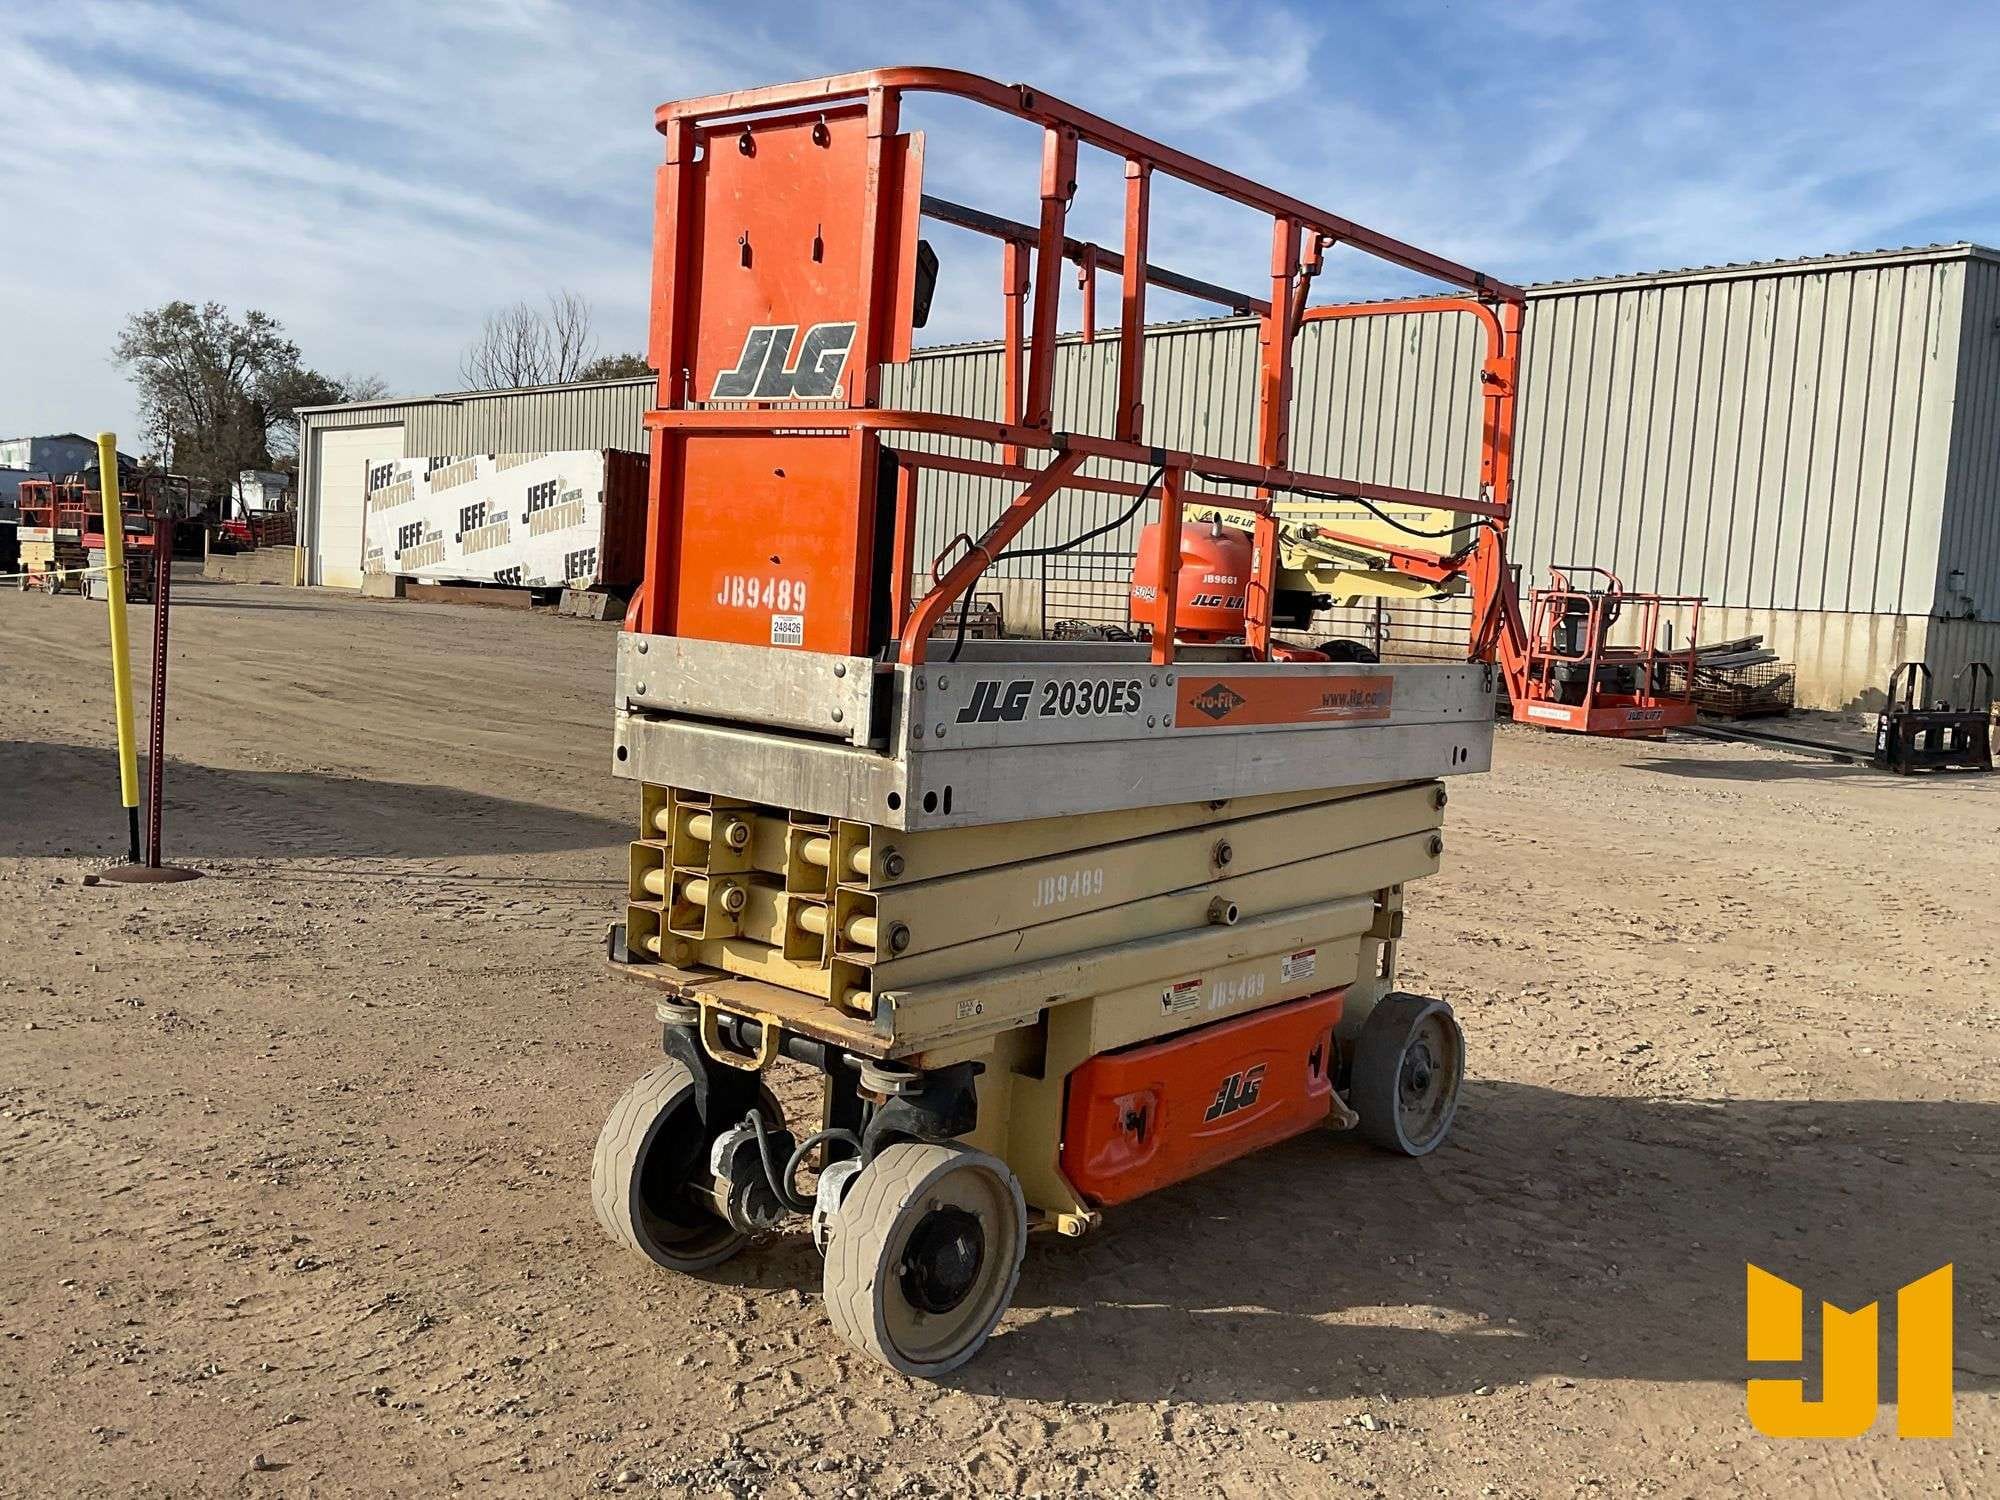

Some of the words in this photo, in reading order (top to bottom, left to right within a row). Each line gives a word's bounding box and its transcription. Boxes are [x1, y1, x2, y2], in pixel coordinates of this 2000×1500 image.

[711, 323, 857, 399] JLG
[366, 462, 394, 501] JEFF
[431, 459, 475, 494] MARTIN
[371, 480, 412, 513] MARTIN
[522, 479, 557, 524] JEFF
[455, 502, 485, 543] JEFF
[529, 499, 583, 537] MARTIN
[1241, 518, 1256, 528] LIF
[395, 521, 422, 560] JEFF
[401, 540, 443, 572] MARTIN
[462, 521, 508, 556] MARTIN
[717, 575, 806, 612] JB9489
[1203, 574, 1238, 585] JB9661
[1190, 594, 1224, 608] JLG
[1224, 597, 1245, 609] LI
[774, 621, 801, 634] 248426
[955, 680, 1035, 724] JLG
[1040, 680, 1143, 717] 2030ES
[1321, 690, 1389, 708] www.jlg.co
[1032, 868, 1103, 911] JB9489
[1203, 1063, 1267, 1123] JLG
